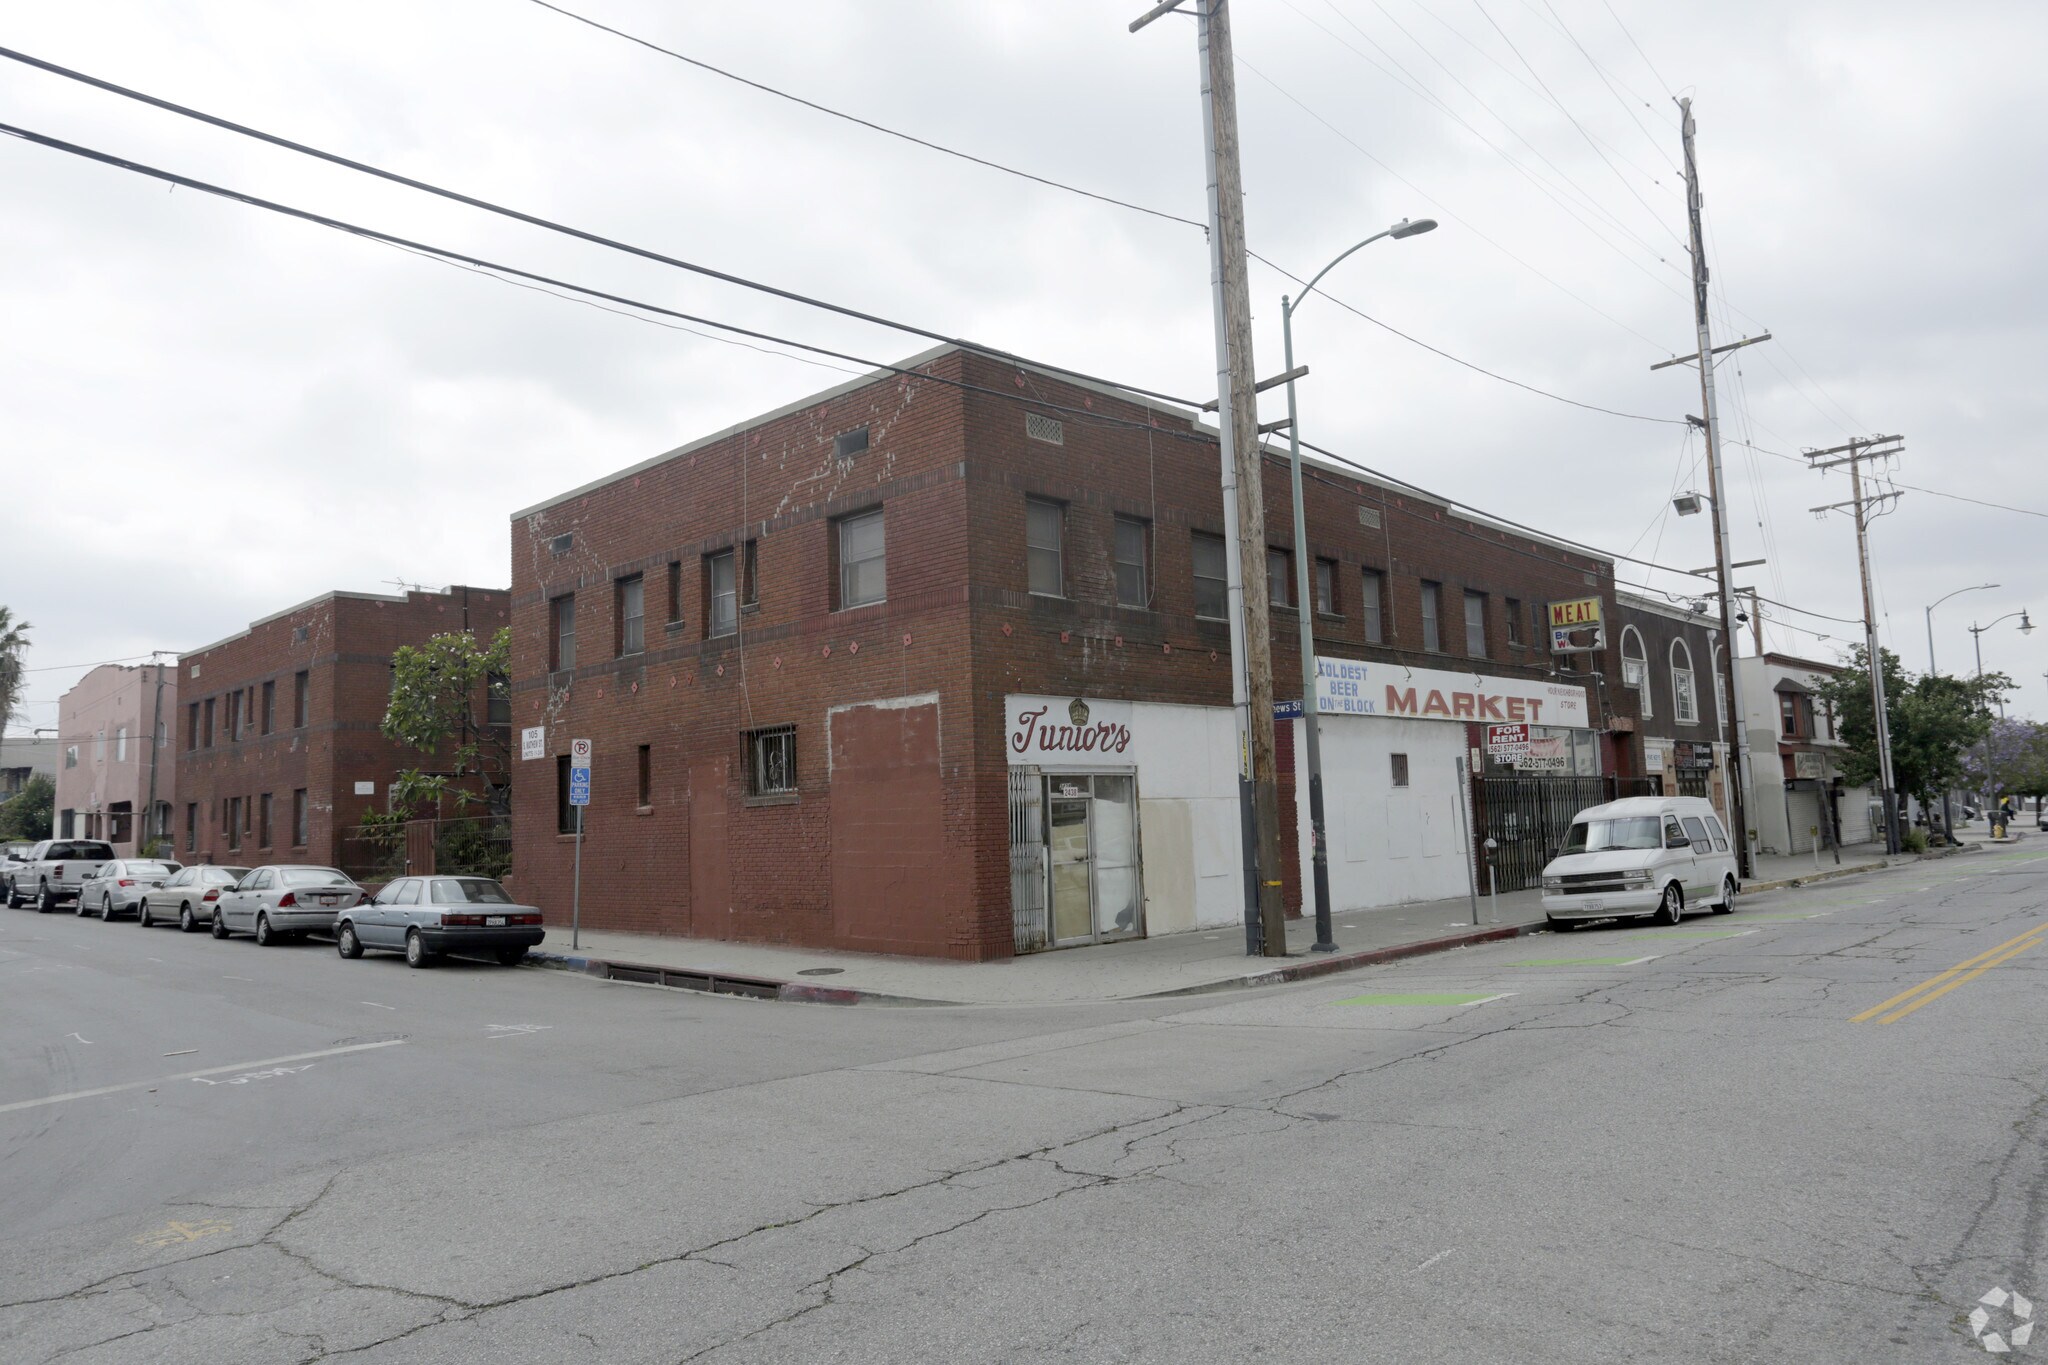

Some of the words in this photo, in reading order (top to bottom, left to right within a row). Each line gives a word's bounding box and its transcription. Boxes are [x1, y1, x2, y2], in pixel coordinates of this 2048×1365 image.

[1553, 602, 1591, 625] MEAT
[1319, 662, 1368, 681] COLDEST
[1330, 681, 1358, 697] BEER
[1292, 701, 1302, 711] St
[1320, 697, 1335, 711] ON
[1334, 700, 1343, 708] THE
[1344, 699, 1375, 714] BLOCK
[1385, 684, 1543, 723] MARKET
[1560, 701, 1577, 710] STORE
[528, 730, 538, 739] 105
[1012, 705, 1131, 754] Junior's
[1496, 725, 1521, 735] FOR
[1492, 733, 1525, 744] RENT
[1488, 745, 1503, 754] (562)
[1503, 743, 1529, 752] 577-0496
[1495, 753, 1522, 763] STORE
